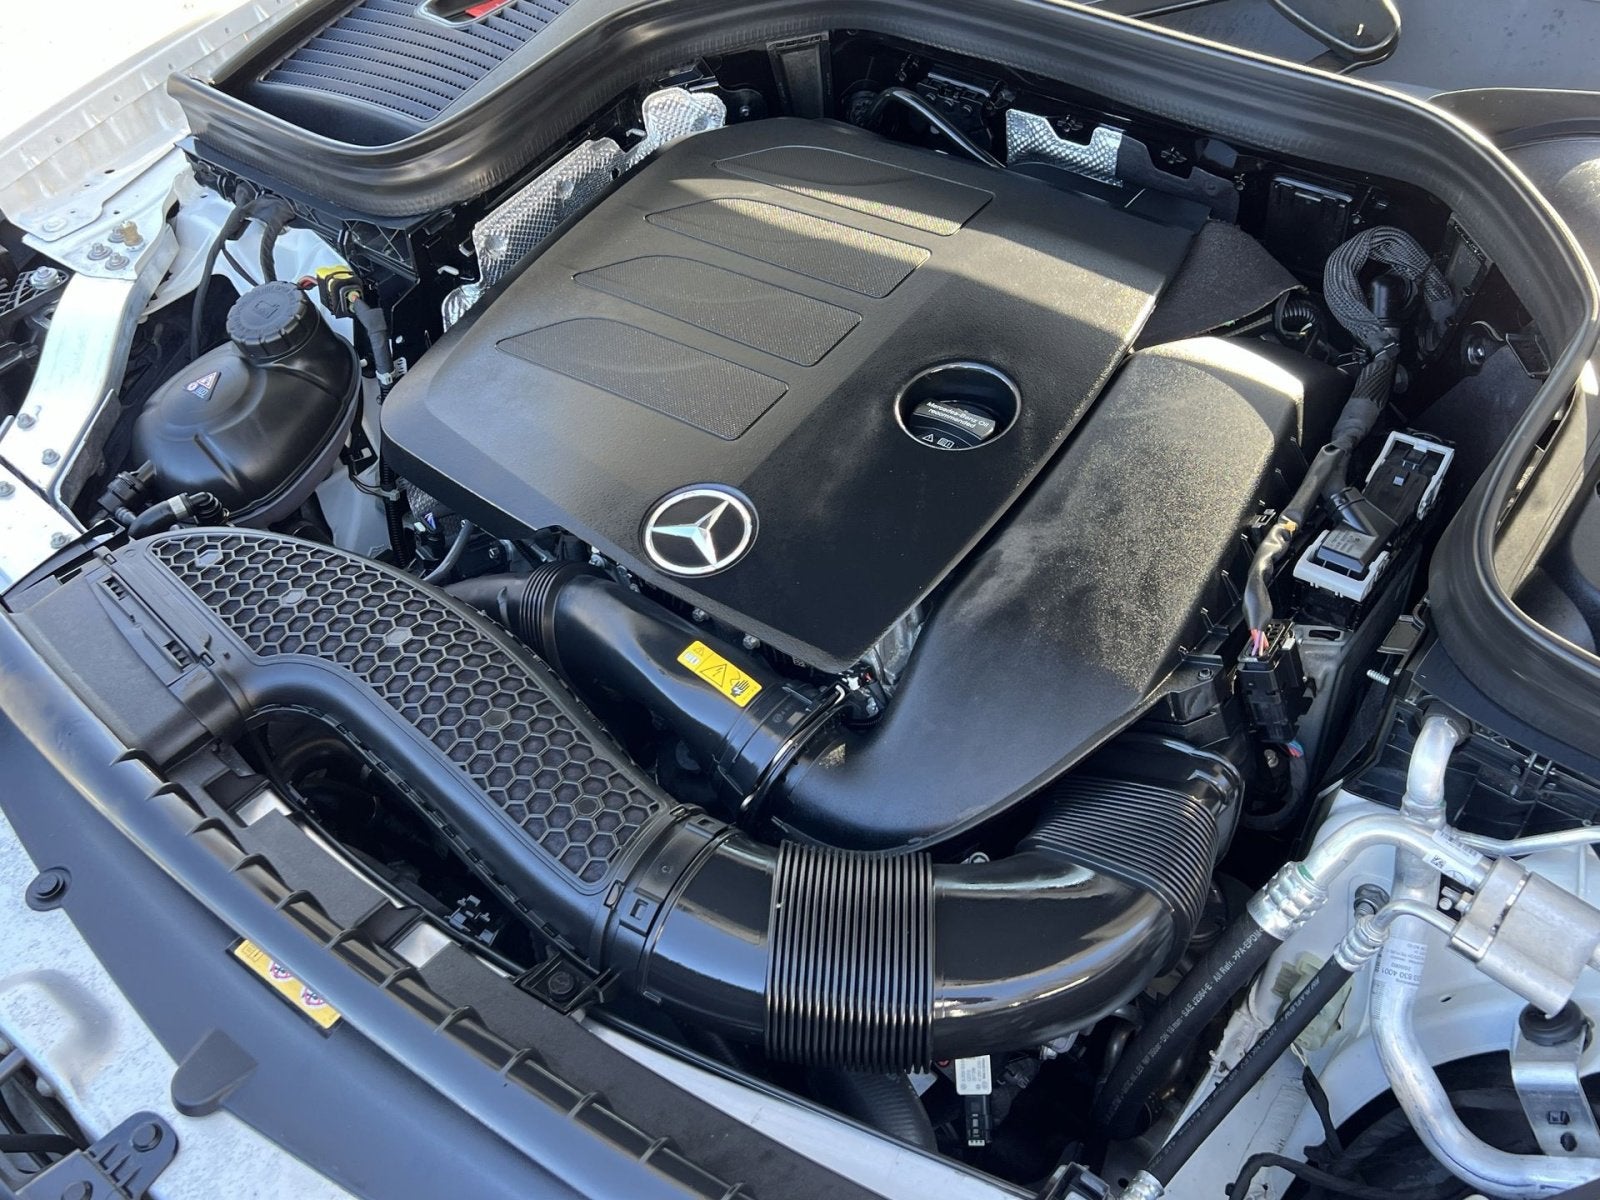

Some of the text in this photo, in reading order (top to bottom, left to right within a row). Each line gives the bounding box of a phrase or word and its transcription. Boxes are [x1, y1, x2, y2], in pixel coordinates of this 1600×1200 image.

[926, 402, 990, 427] Mercedes-Benz Oil
[928, 409, 976, 428] recommended
[1181, 1002, 1195, 1017] SAE
